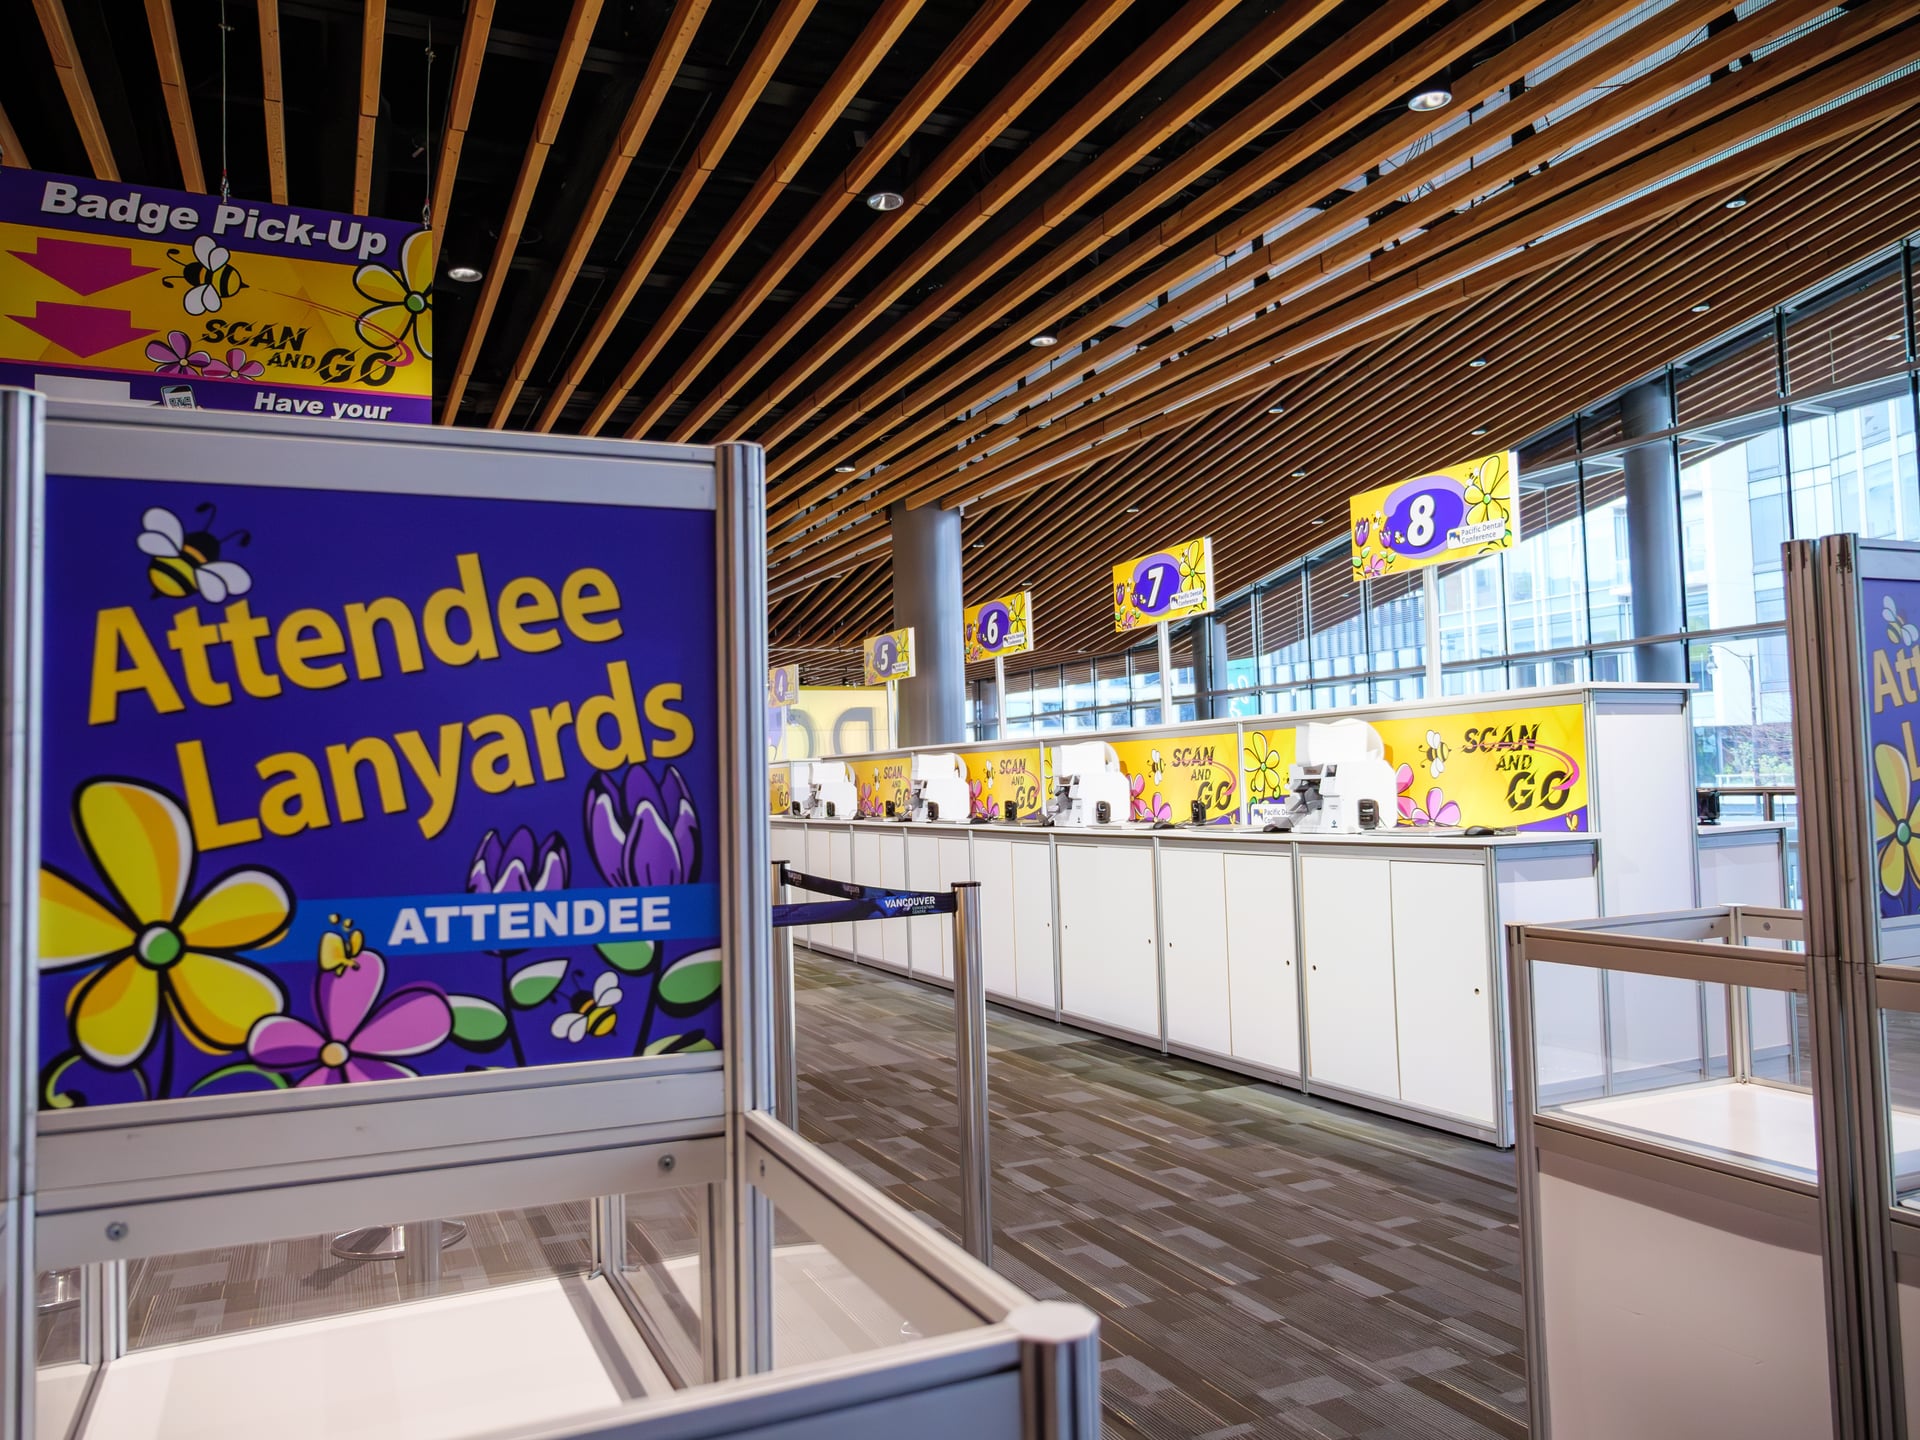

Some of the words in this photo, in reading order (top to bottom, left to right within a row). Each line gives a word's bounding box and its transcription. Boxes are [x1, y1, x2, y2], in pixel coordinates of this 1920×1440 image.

[40, 180, 199, 235] Badge
[213, 204, 388, 260] Pick-Up
[199, 319, 310, 352] SCAN
[267, 352, 316, 370] AND
[315, 347, 401, 387] GO
[254, 391, 324, 415] Have
[330, 400, 393, 420] your
[1407, 494, 1436, 547] 8
[1482, 520, 1504, 531] Dental
[1147, 565, 1164, 608] 7
[88, 552, 624, 726] Attendee
[987, 611, 999, 645] 6
[880, 643, 889, 671] 5
[1462, 721, 1541, 754] SCAN
[175, 660, 696, 853] Lanyards
[999, 757, 1027, 775] SCAN
[1172, 745, 1215, 767] SCAN
[1496, 754, 1533, 771] AND
[883, 765, 903, 780] SCAN
[1011, 775, 1025, 786] AND
[1190, 768, 1212, 781] AND
[1016, 785, 1038, 810] GO
[1197, 780, 1232, 811] GO
[1505, 770, 1571, 812] GO
[884, 895, 936, 909] VANCOUVER
[388, 896, 671, 947] ATTENDEE
